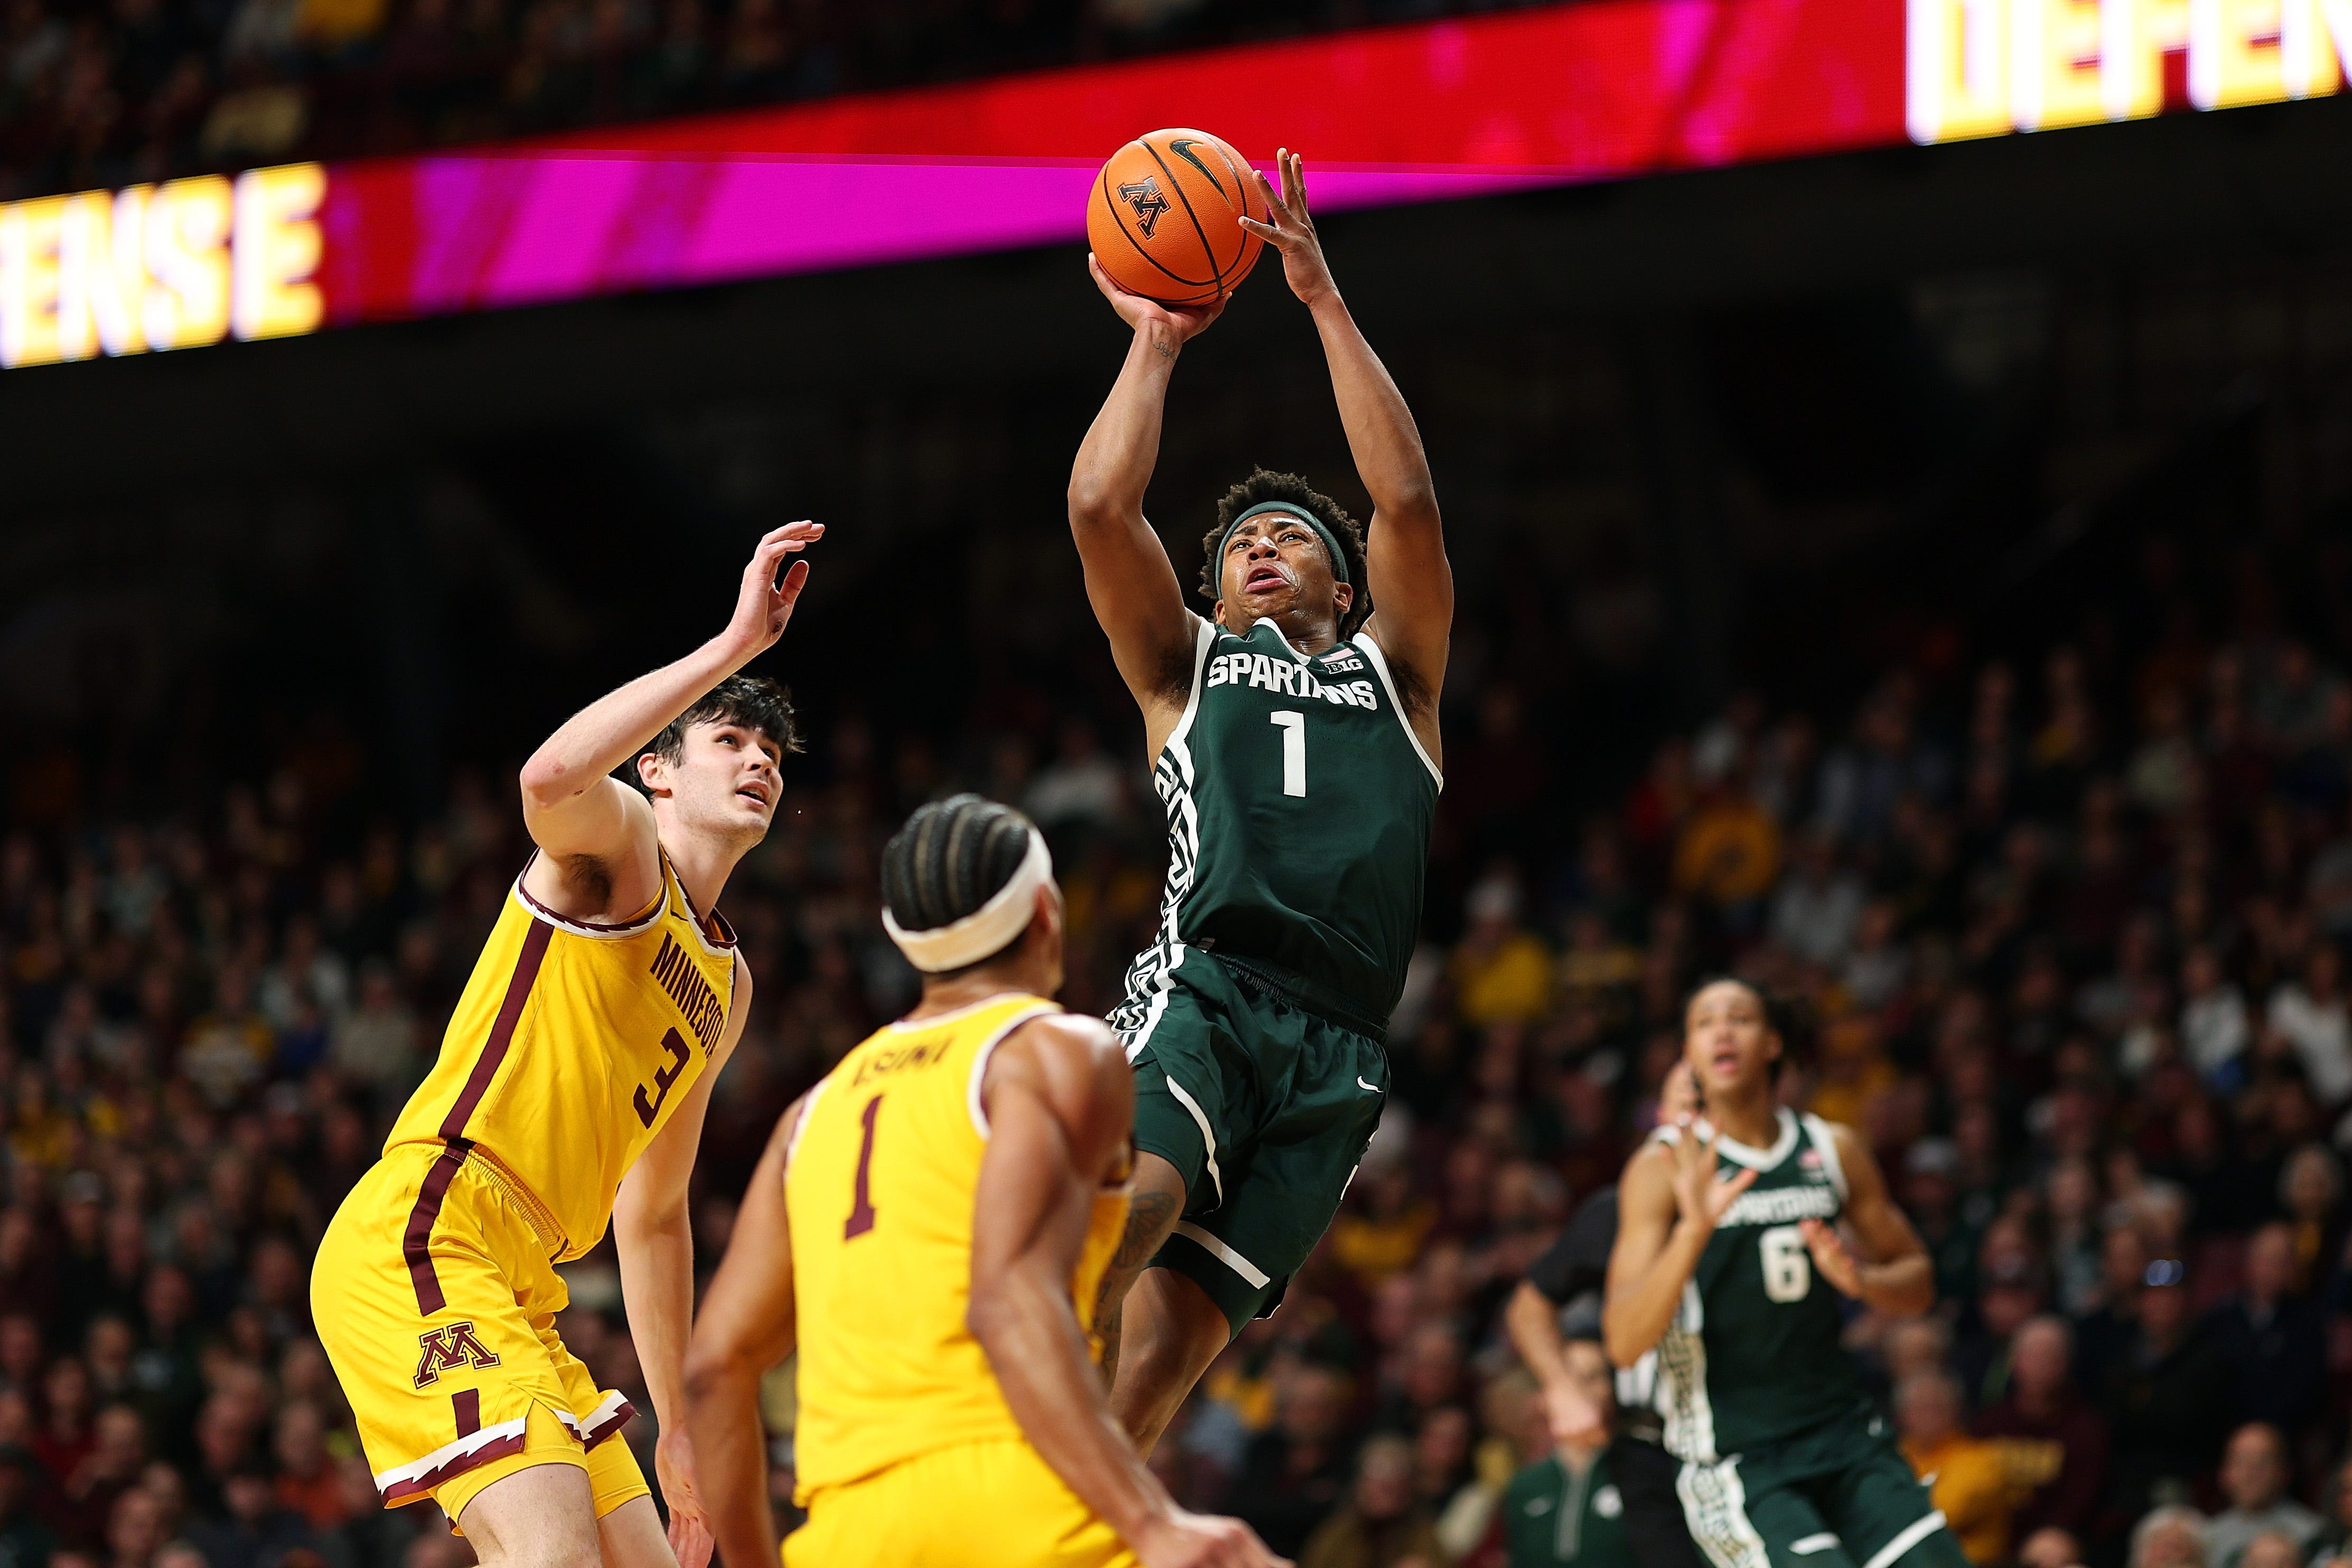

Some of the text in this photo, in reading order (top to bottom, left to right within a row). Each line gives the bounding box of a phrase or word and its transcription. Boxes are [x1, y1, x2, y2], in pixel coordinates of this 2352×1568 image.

[1117, 176, 1171, 240] M
[1208, 653, 1377, 711] SPARTANS
[1270, 710, 1306, 798] 1
[633, 1026, 691, 1130] 3
[844, 1091, 884, 1242] 1
[1760, 1225, 1810, 1303] 6
[413, 1321, 503, 1390] M
